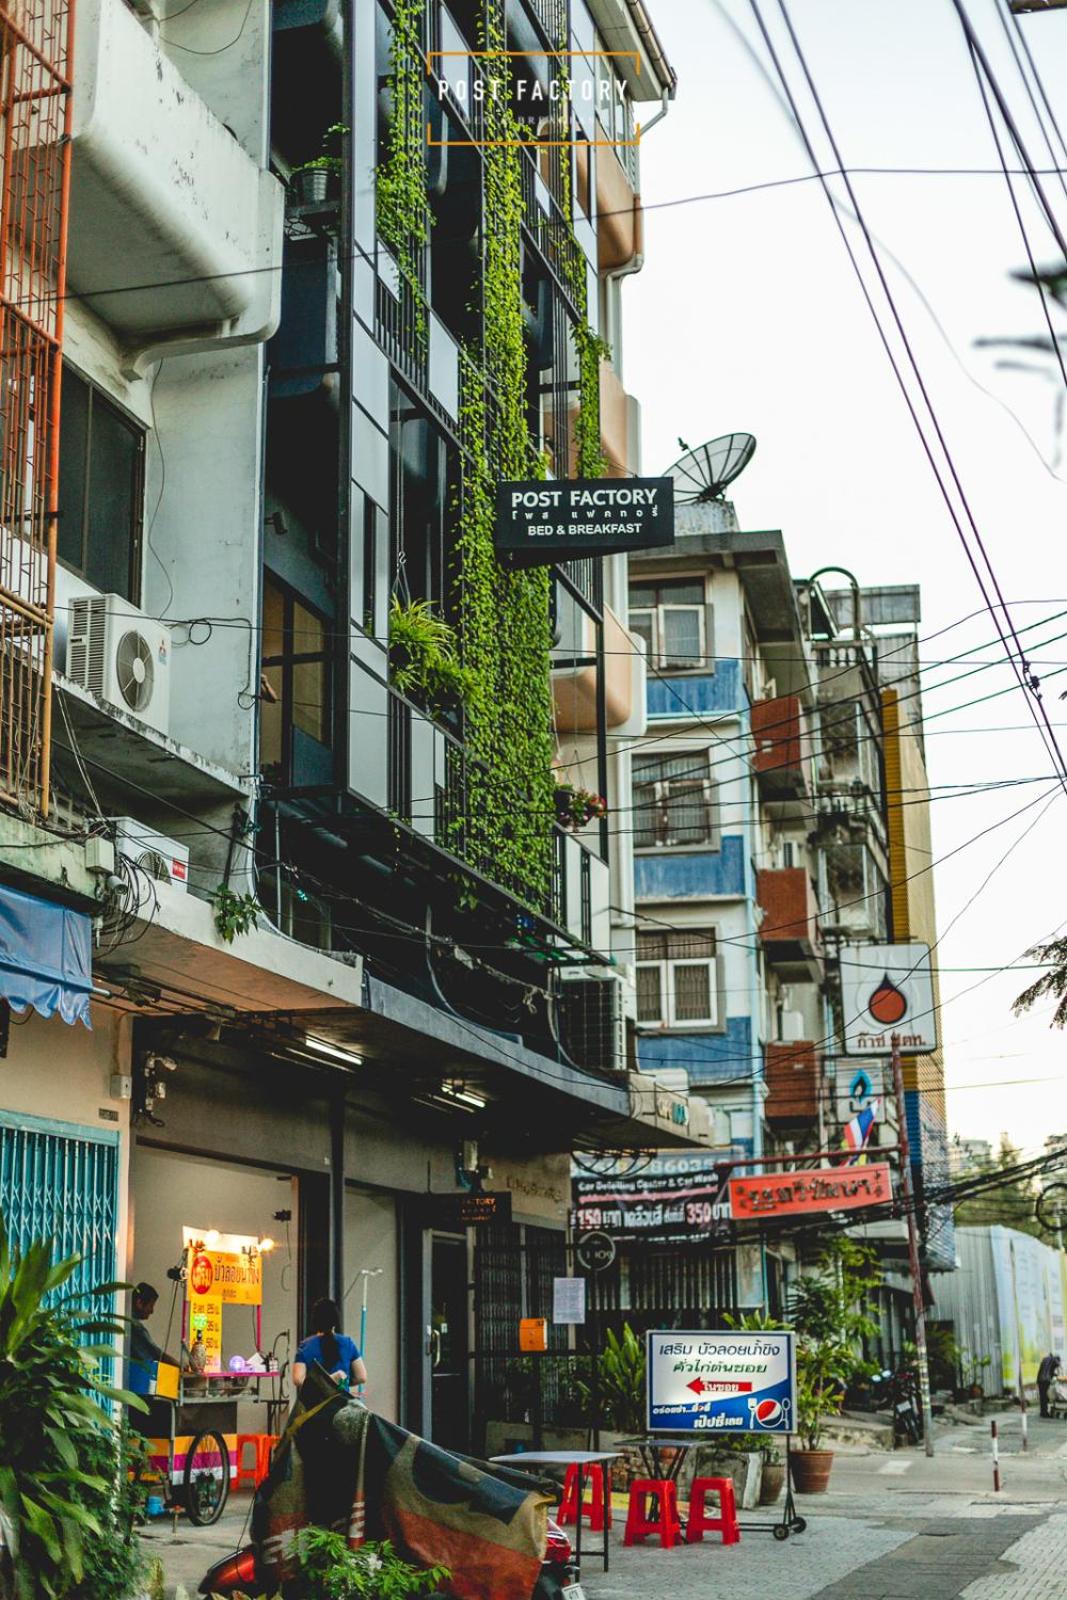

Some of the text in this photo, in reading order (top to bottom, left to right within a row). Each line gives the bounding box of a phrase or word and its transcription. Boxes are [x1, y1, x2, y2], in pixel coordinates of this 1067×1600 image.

[511, 488, 657, 508] POST FACTORY
[527, 523, 642, 536] BED & BREAKFAST
[687, 1203, 711, 1224] 350
[659, 1339, 780, 1356] เสริม บัวลอยน้ำขิง
